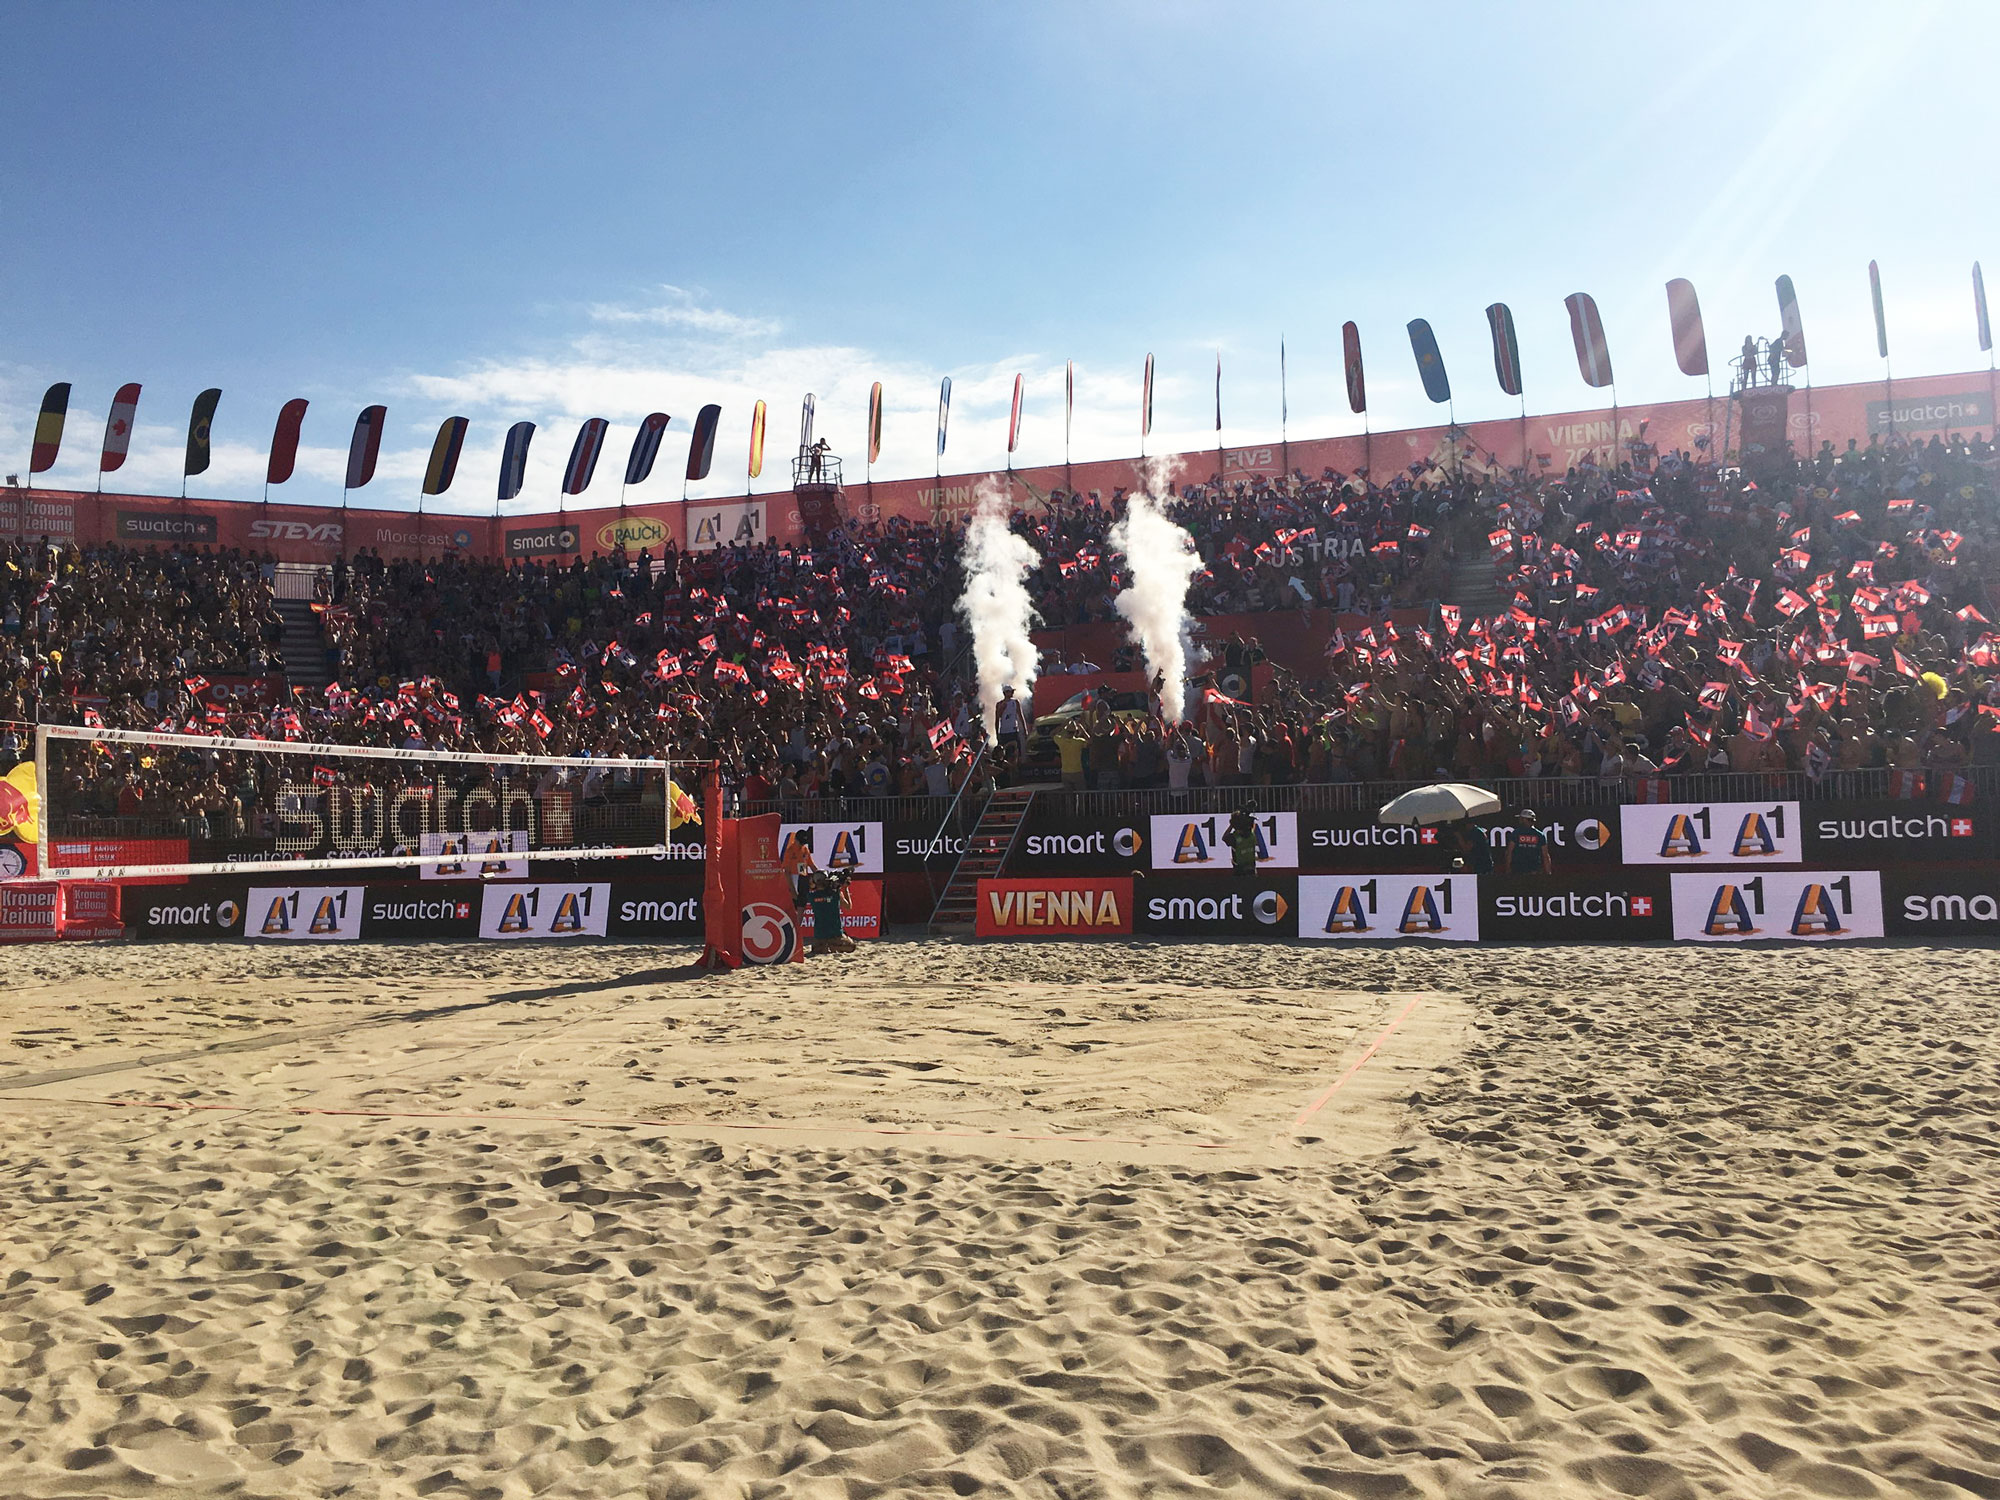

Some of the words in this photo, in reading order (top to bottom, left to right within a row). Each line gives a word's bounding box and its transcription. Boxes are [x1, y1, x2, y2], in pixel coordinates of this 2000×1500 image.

[1878, 403, 1964, 425] swatch
[1547, 419, 1633, 446] VIENNA
[26, 501, 73, 516] Kronen
[25, 516, 72, 532] Zeitung
[126, 519, 195, 534] swatch
[249, 520, 344, 541] STEYR
[612, 525, 662, 546] RAUCH
[694, 512, 722, 545] A1
[734, 508, 761, 541] A1
[376, 527, 450, 546] Morecast
[513, 533, 556, 549] smart
[212, 684, 266, 700] OR
[275, 774, 536, 850] swatch
[1312, 824, 1418, 847] swatch
[1482, 822, 1565, 847] mrt
[1661, 807, 1711, 857] A1
[1733, 805, 1785, 856] A1
[1819, 815, 1948, 839] swatch
[829, 826, 866, 868] A1
[1027, 831, 1105, 855] smart
[1173, 817, 1216, 864] A1
[2, 890, 56, 906] Kronen
[74, 889, 107, 900] Kronen
[75, 900, 107, 911] Zeitung
[1326, 878, 1377, 933] A1
[1400, 878, 1453, 933] A1
[1496, 892, 1627, 917] swatch
[1704, 876, 1764, 935] A1
[1791, 875, 1852, 935] A1
[2, 908, 55, 926] Zeitung
[148, 903, 210, 925] smart
[262, 890, 300, 934] A1
[309, 890, 348, 934] A1
[372, 899, 455, 920] swatch
[499, 887, 541, 933] A1
[550, 886, 593, 932] A1
[620, 898, 697, 922] smart
[989, 891, 1121, 926] VIENNA
[1148, 894, 1243, 920] smart
[1904, 894, 1998, 921] sma
